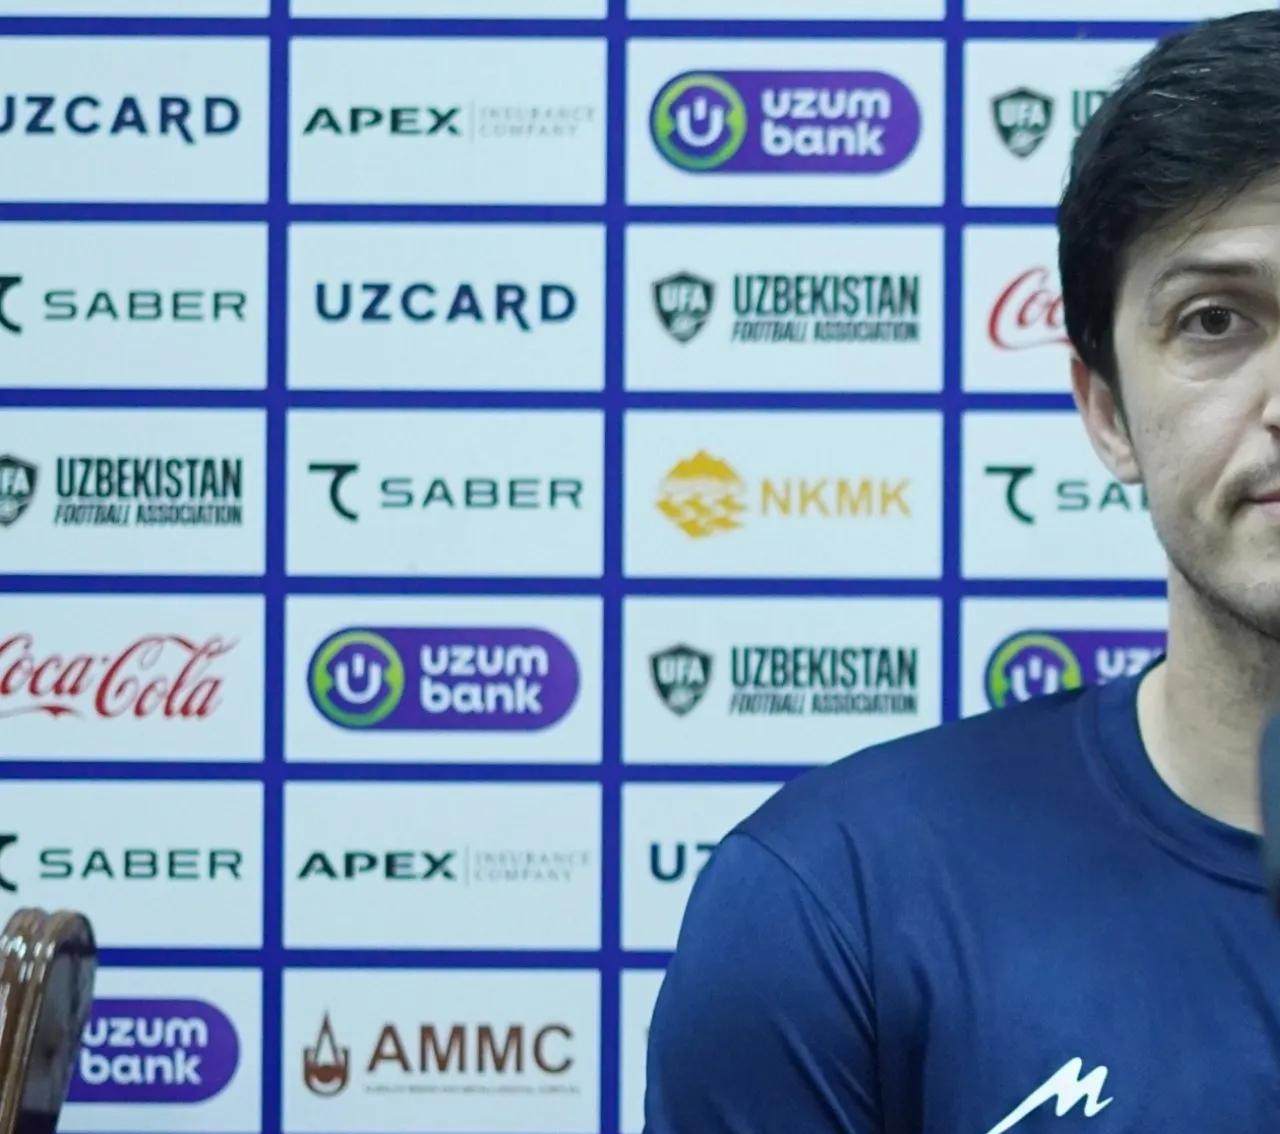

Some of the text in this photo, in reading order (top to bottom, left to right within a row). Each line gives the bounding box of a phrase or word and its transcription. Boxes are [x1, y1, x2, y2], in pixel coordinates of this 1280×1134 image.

[761, 88, 891, 119] uzum
[302, 106, 460, 136] APEX
[761, 119, 884, 156] bank
[43, 289, 247, 322] SABER
[315, 281, 578, 333] UZCARD
[733, 273, 920, 317] UZBEKISTAN
[56, 456, 243, 500] UZBEKISTAN
[379, 477, 584, 509] SABER
[761, 479, 909, 515] NKMK
[420, 645, 549, 679] uzum
[731, 646, 918, 692] UZBEKISTAN
[420, 680, 542, 713] bank
[38, 848, 243, 880] SABER
[297, 850, 455, 881] APEX
[81, 1016, 210, 1048] uzum
[366, 1023, 574, 1075] AMMC
[80, 1048, 205, 1085] bank
